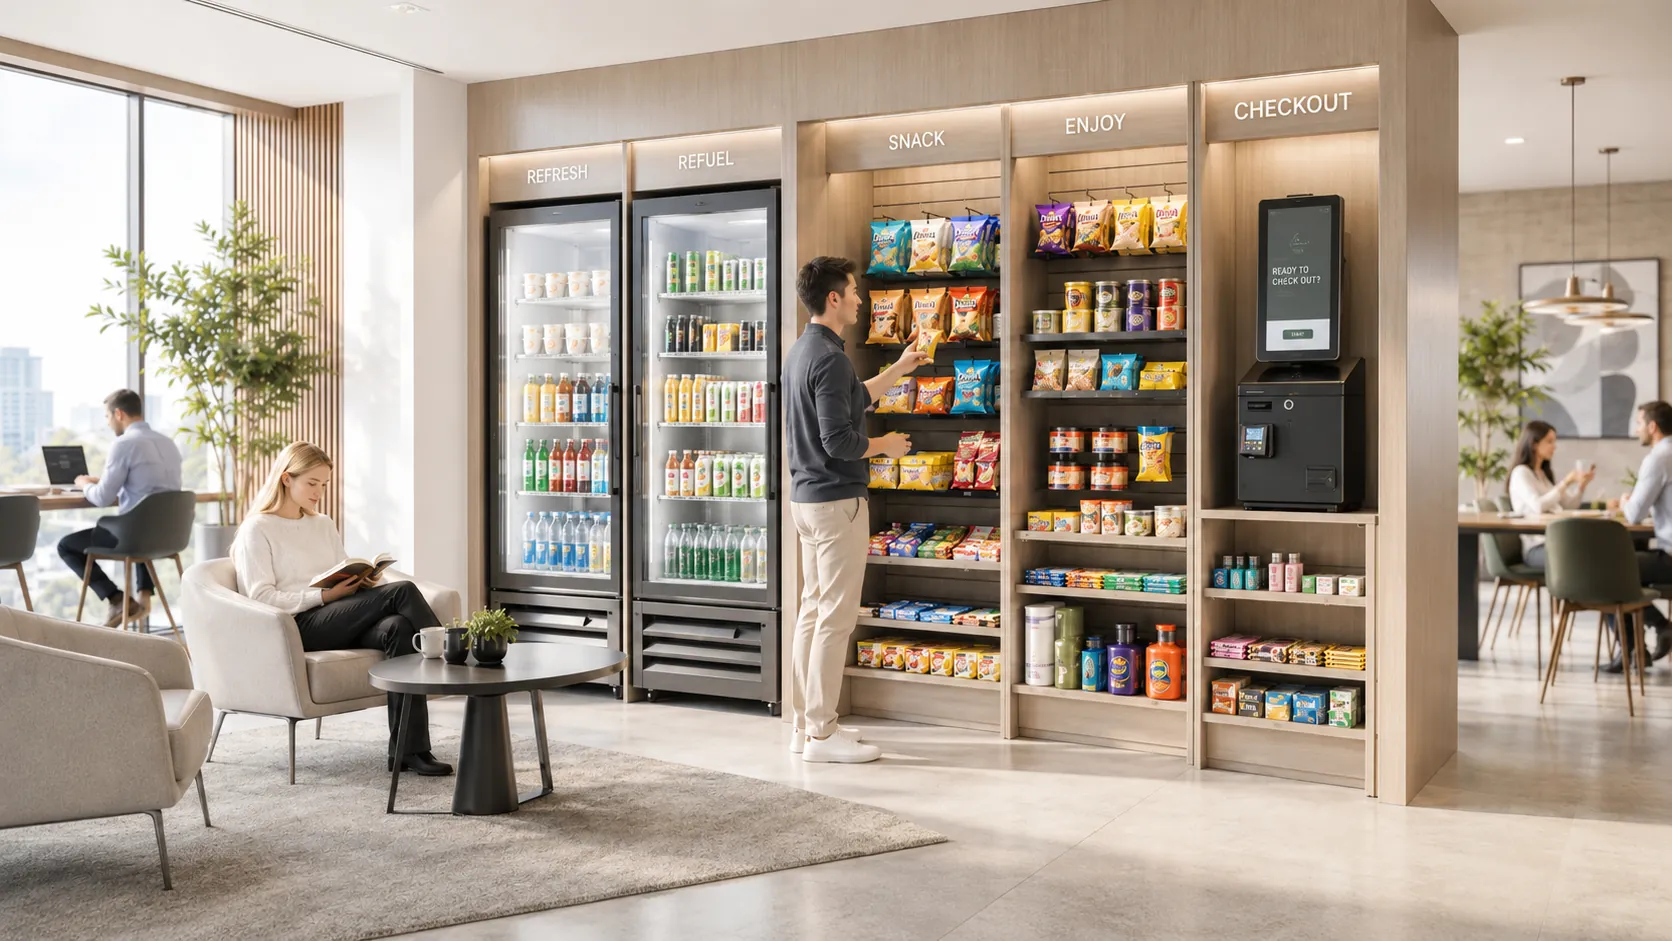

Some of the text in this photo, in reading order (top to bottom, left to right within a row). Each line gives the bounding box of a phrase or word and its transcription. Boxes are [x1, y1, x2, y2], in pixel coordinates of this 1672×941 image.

[1234, 91, 1353, 120] CHECKOUT
[1065, 112, 1127, 135] ENJOY
[888, 130, 946, 151] SNACK
[678, 150, 735, 170] REFUEL
[526, 163, 589, 184] REFRESH
[1272, 265, 1309, 276] READY TO
[1272, 275, 1321, 286] CHECK OUT?
